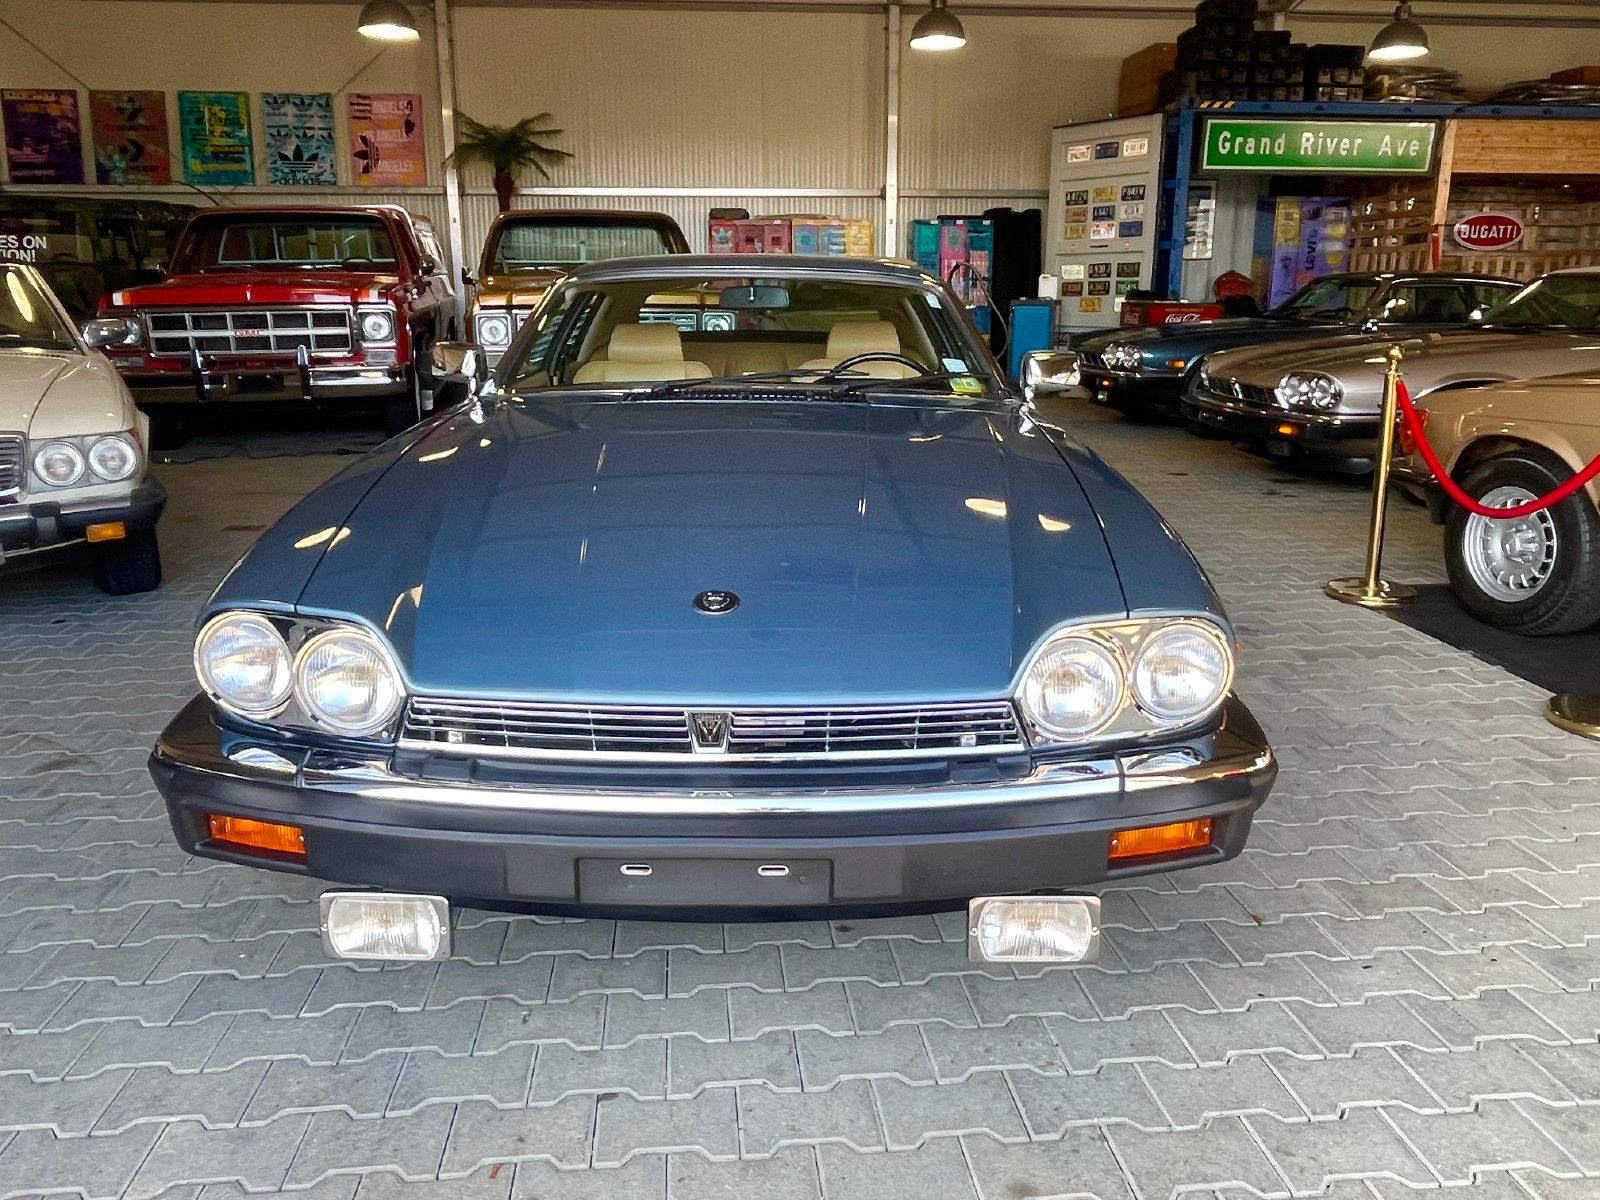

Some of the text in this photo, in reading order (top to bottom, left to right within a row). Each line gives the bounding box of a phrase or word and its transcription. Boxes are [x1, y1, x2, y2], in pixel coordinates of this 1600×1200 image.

[1217, 131, 1421, 157] Grand River Ave
[1460, 223, 1518, 240] BUGATTI
[22, 235, 48, 249] ON
